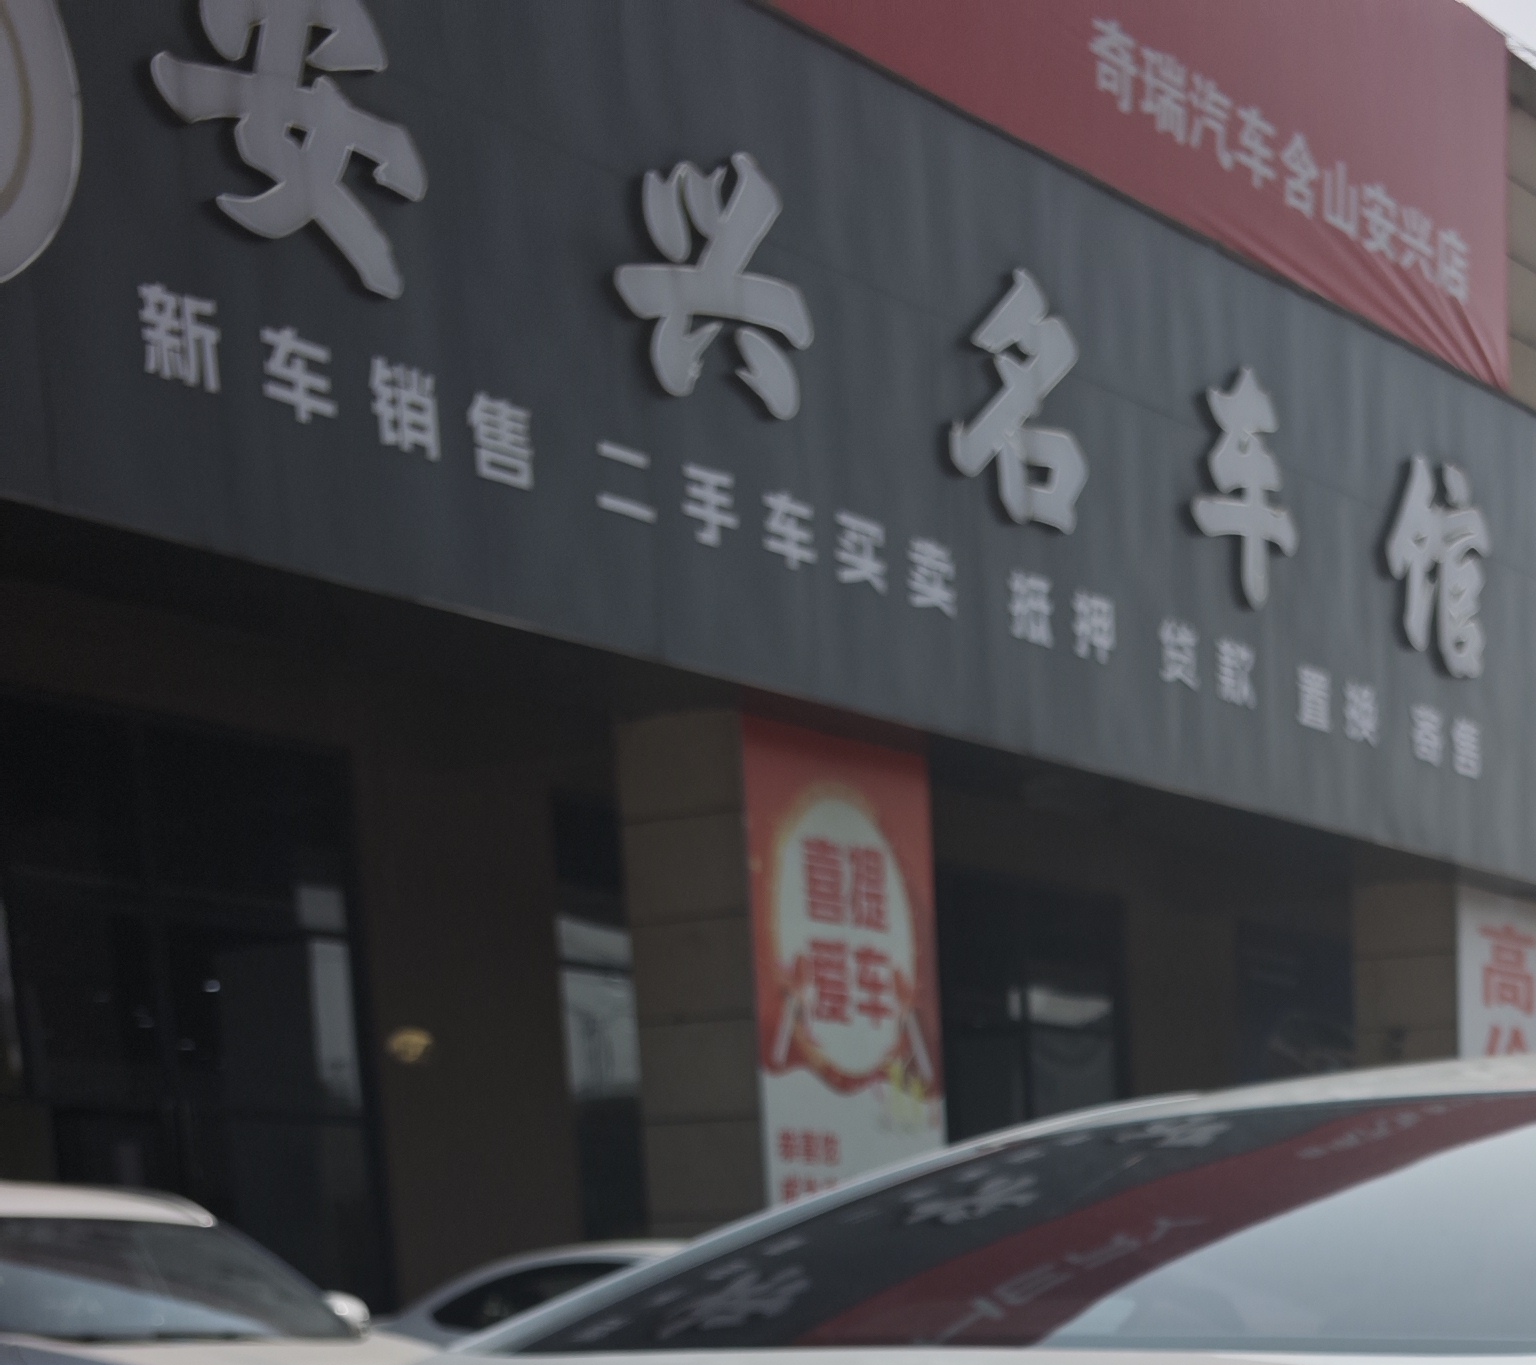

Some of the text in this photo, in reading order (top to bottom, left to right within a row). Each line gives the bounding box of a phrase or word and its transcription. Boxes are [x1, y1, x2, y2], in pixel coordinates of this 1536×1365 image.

[1088, 17, 1470, 302] 奇瑞汽车含山安兴店
[136, 282, 535, 491] 新车销售
[596, 440, 958, 619] 二手车买卖
[1006, 568, 1117, 665] 抵押
[150, 0, 1492, 678] 安兴名车馆
[802, 836, 889, 932] 喜提
[810, 937, 893, 1029] 爱车
